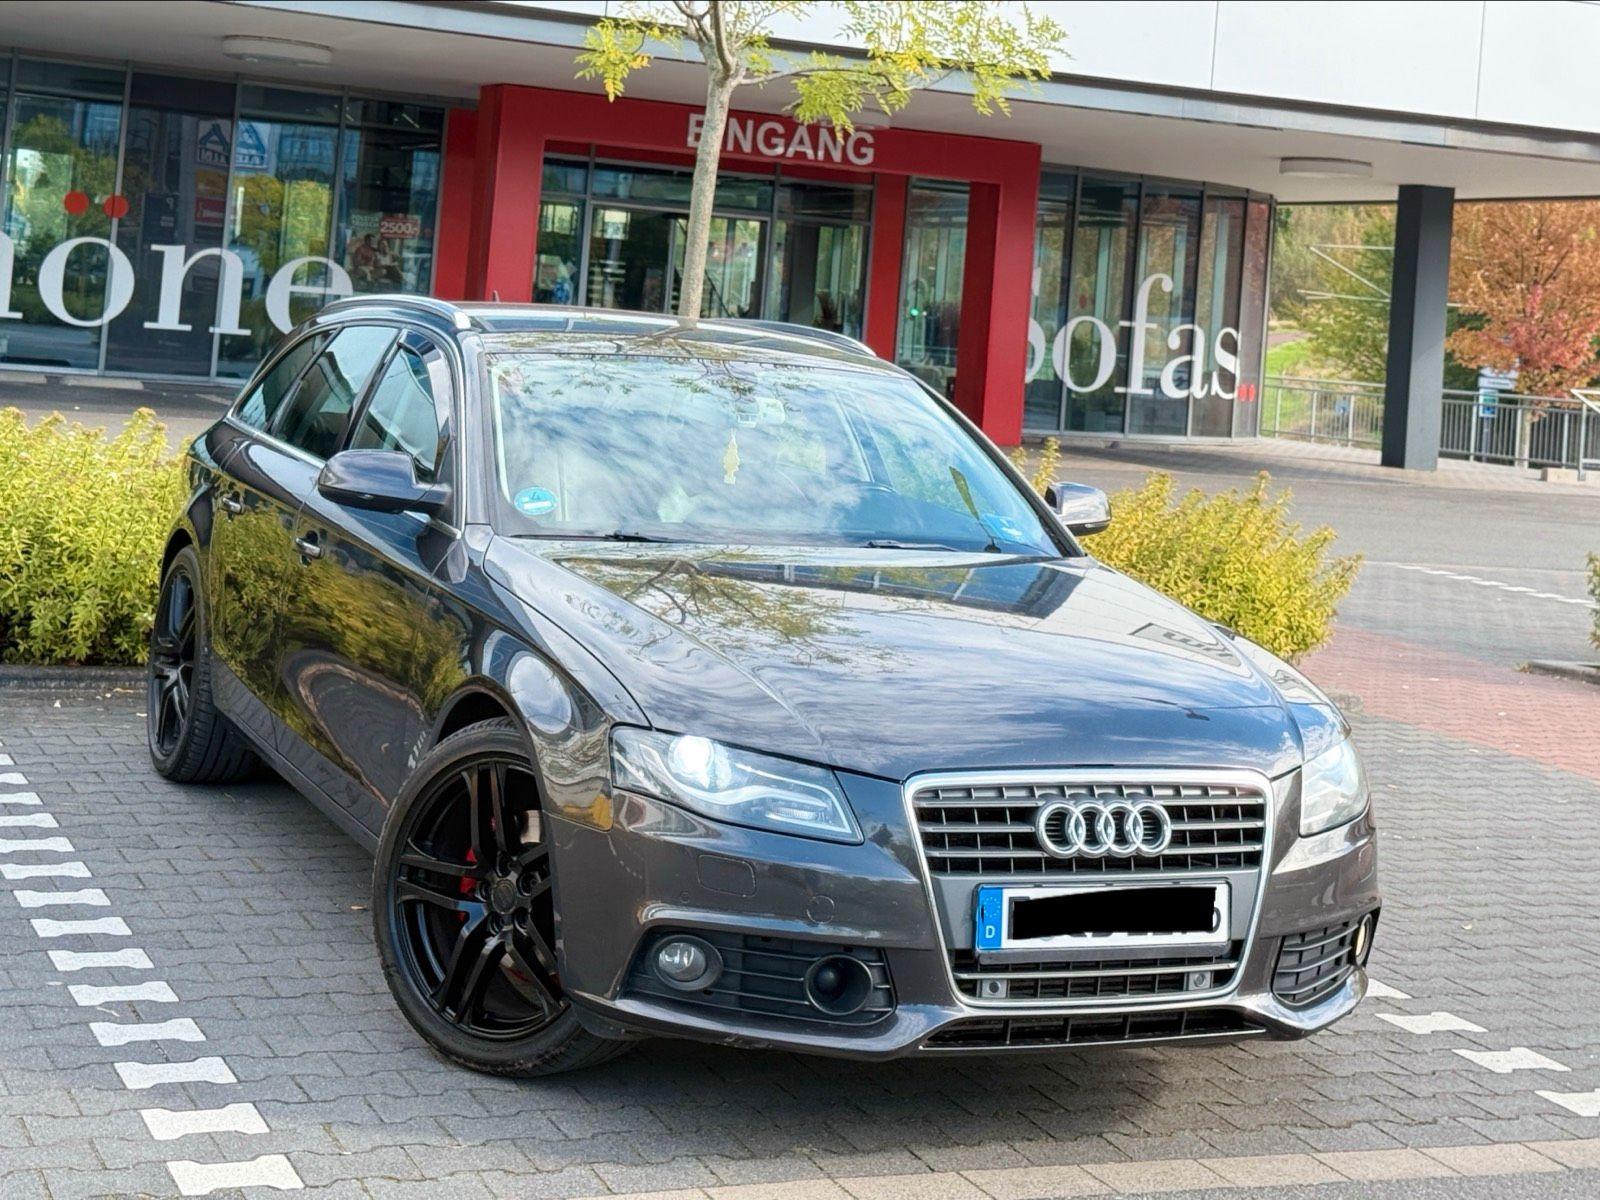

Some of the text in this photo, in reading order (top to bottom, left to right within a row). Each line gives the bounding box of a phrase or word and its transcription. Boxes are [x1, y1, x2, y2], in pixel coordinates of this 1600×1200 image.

[687, 113, 875, 166] ENGANG
[0, 190, 354, 336] öne
[985, 925, 995, 939] D
